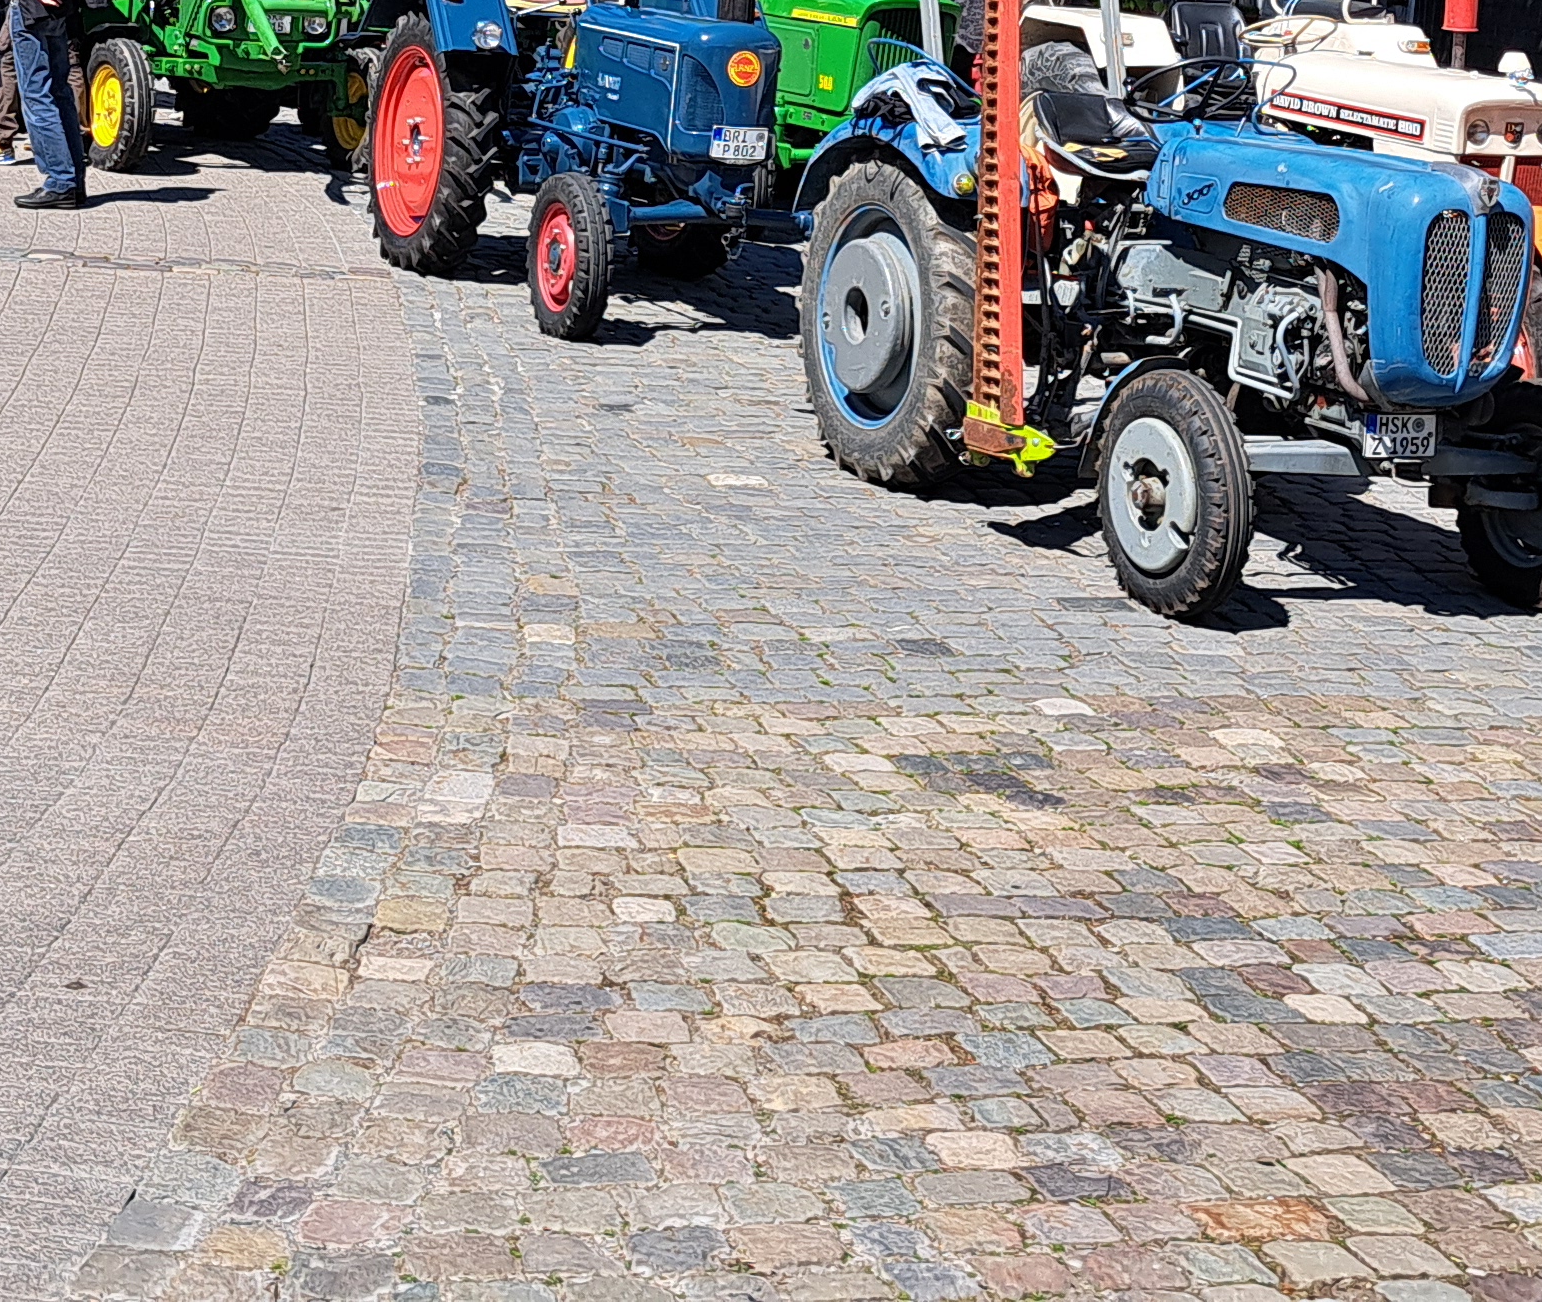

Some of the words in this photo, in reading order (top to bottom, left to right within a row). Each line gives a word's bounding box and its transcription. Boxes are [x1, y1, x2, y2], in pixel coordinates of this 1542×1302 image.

[1273, 94, 1301, 110] DAVID
[1301, 99, 1338, 118] BROWN
[1339, 108, 1397, 130] SELECTAMATIC
[732, 145, 757, 157] 802
[1379, 416, 1411, 434] HSK
[1389, 436, 1430, 455] 1959
